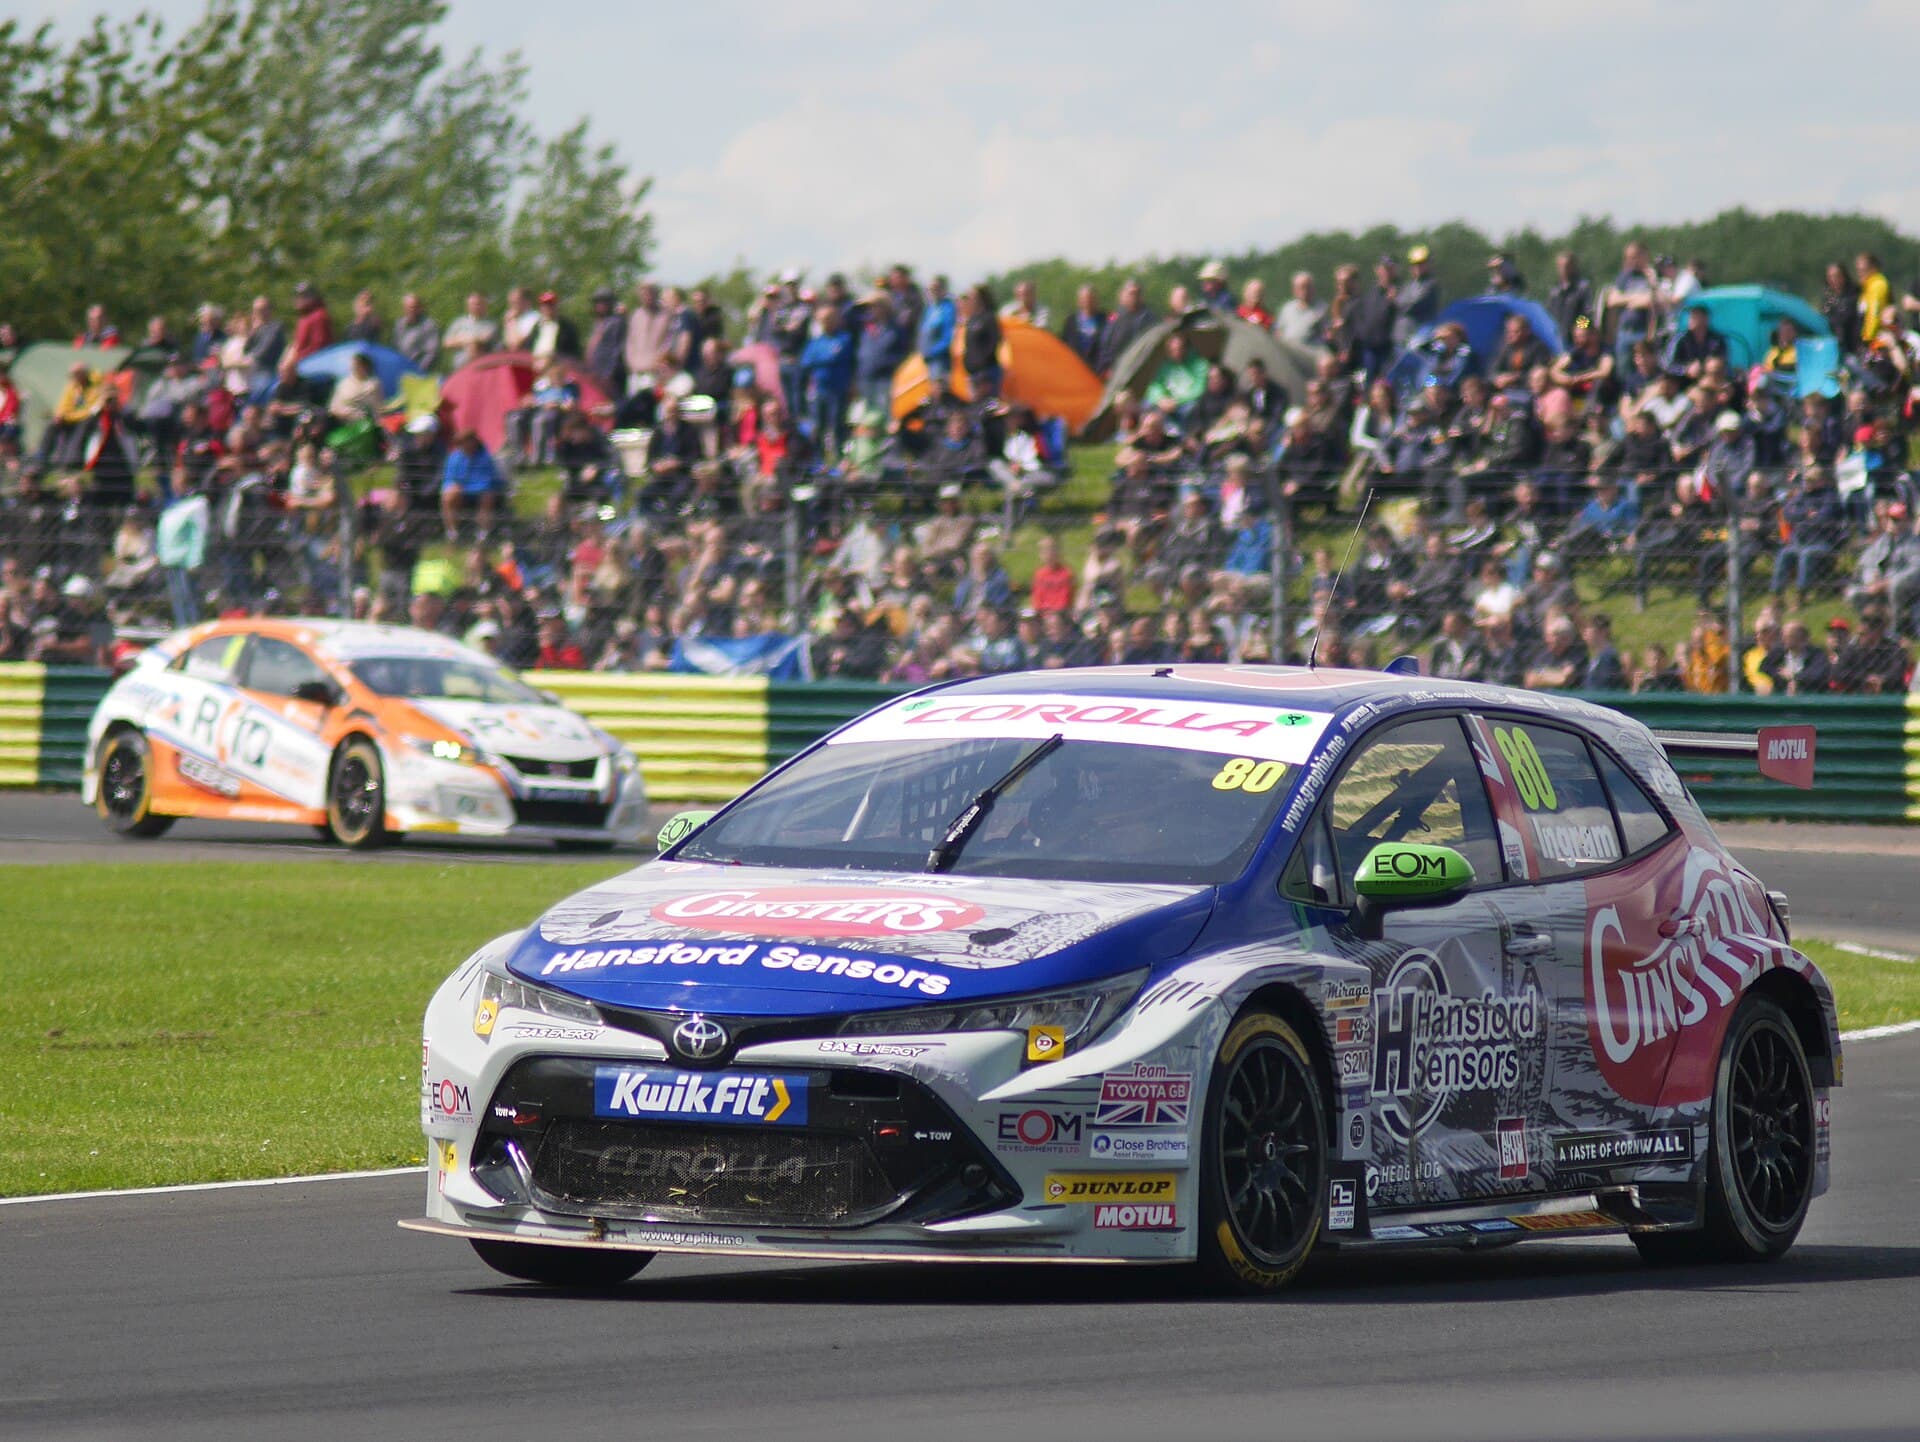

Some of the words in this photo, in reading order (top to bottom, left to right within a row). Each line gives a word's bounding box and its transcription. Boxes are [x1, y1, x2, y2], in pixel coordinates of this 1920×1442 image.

[904, 703, 1273, 737] COROLLA
[1768, 739, 1807, 759] MOTUL
[1211, 758, 1287, 793] 80
[1494, 727, 1558, 810] 80
[1281, 735, 1346, 833] www.graphix.me
[1532, 815, 1618, 868] Ingram
[1375, 852, 1446, 878] EOM
[664, 891, 966, 931] GINSTERS
[541, 943, 758, 975] Hansford
[762, 946, 951, 996] Sensors
[1416, 984, 1536, 1042] Hansford
[1133, 1062, 1167, 1079] Team
[1343, 1053, 1368, 1075] S2M
[1414, 1043, 1521, 1092] Sensors
[432, 1079, 472, 1115] EOM
[1107, 1083, 1166, 1099] TOYOTA
[1168, 1084, 1187, 1098] GB
[929, 1131, 952, 1141] TOW
[998, 1109, 1082, 1145] EOM
[997, 1145, 1064, 1153] DEVELOPMENTS
[1113, 1138, 1144, 1151] Close
[1146, 1138, 1187, 1151] Brothers
[1559, 1151, 1566, 1162] A
[1569, 1144, 1597, 1161] TASTE
[1600, 1142, 1612, 1158] OF
[1614, 1136, 1685, 1156] CORNWALL
[1070, 1180, 1171, 1195] DUNLOP
[1097, 1206, 1173, 1226] MOTUL
[640, 1228, 744, 1246] www.graphix.me
